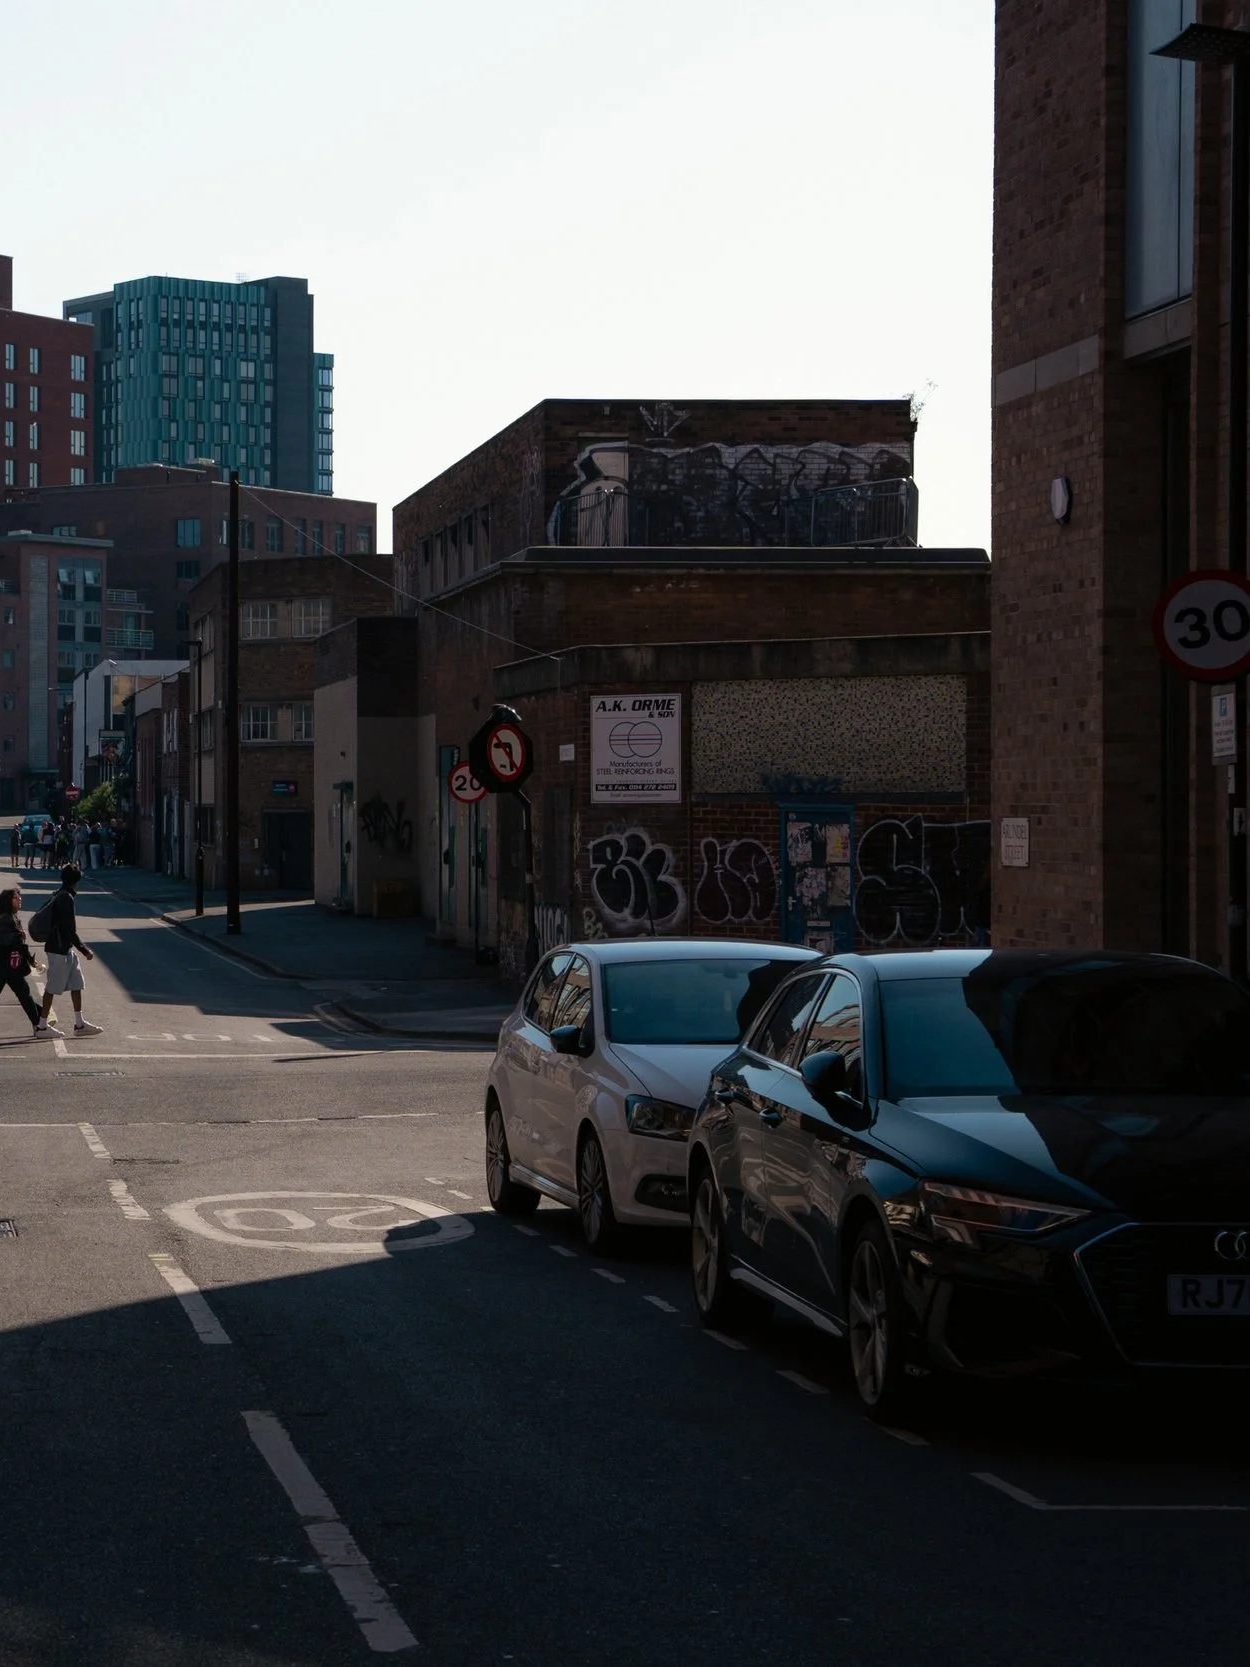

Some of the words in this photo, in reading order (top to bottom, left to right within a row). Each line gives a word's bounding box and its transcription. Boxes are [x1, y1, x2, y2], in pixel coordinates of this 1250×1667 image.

[1174, 599, 1250, 649] 30
[595, 700, 627, 712] A.K.
[631, 698, 676, 711] ORME
[455, 774, 482, 791] 20
[1182, 1279, 1250, 1308] RJ7
